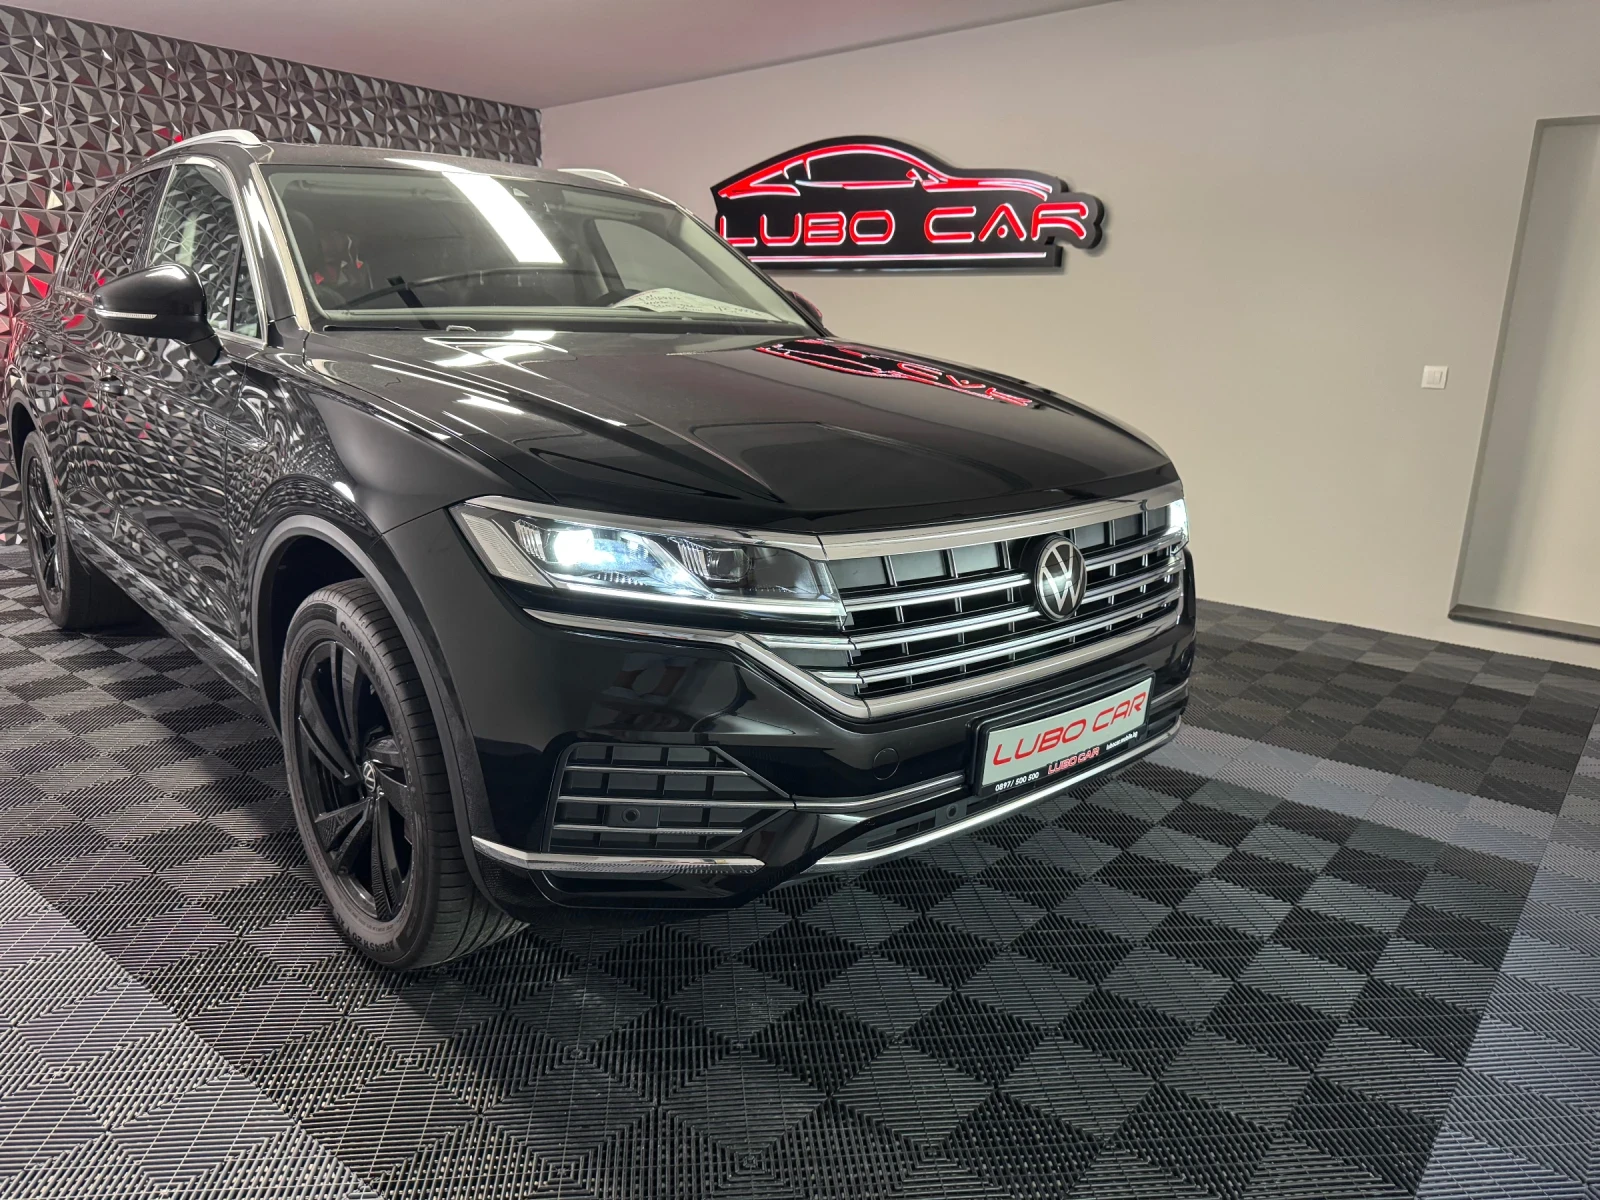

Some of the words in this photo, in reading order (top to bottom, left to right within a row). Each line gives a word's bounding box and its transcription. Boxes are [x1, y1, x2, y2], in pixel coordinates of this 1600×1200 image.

[718, 209, 896, 248] LUBO
[923, 201, 1089, 244] CAR
[992, 718, 1087, 766] LUBO
[1092, 691, 1147, 733] CAR
[1015, 775, 1027, 786] 500
[1027, 771, 1040, 781] 500
[1047, 755, 1078, 775] LUBO
[1077, 746, 1100, 764] CAR
